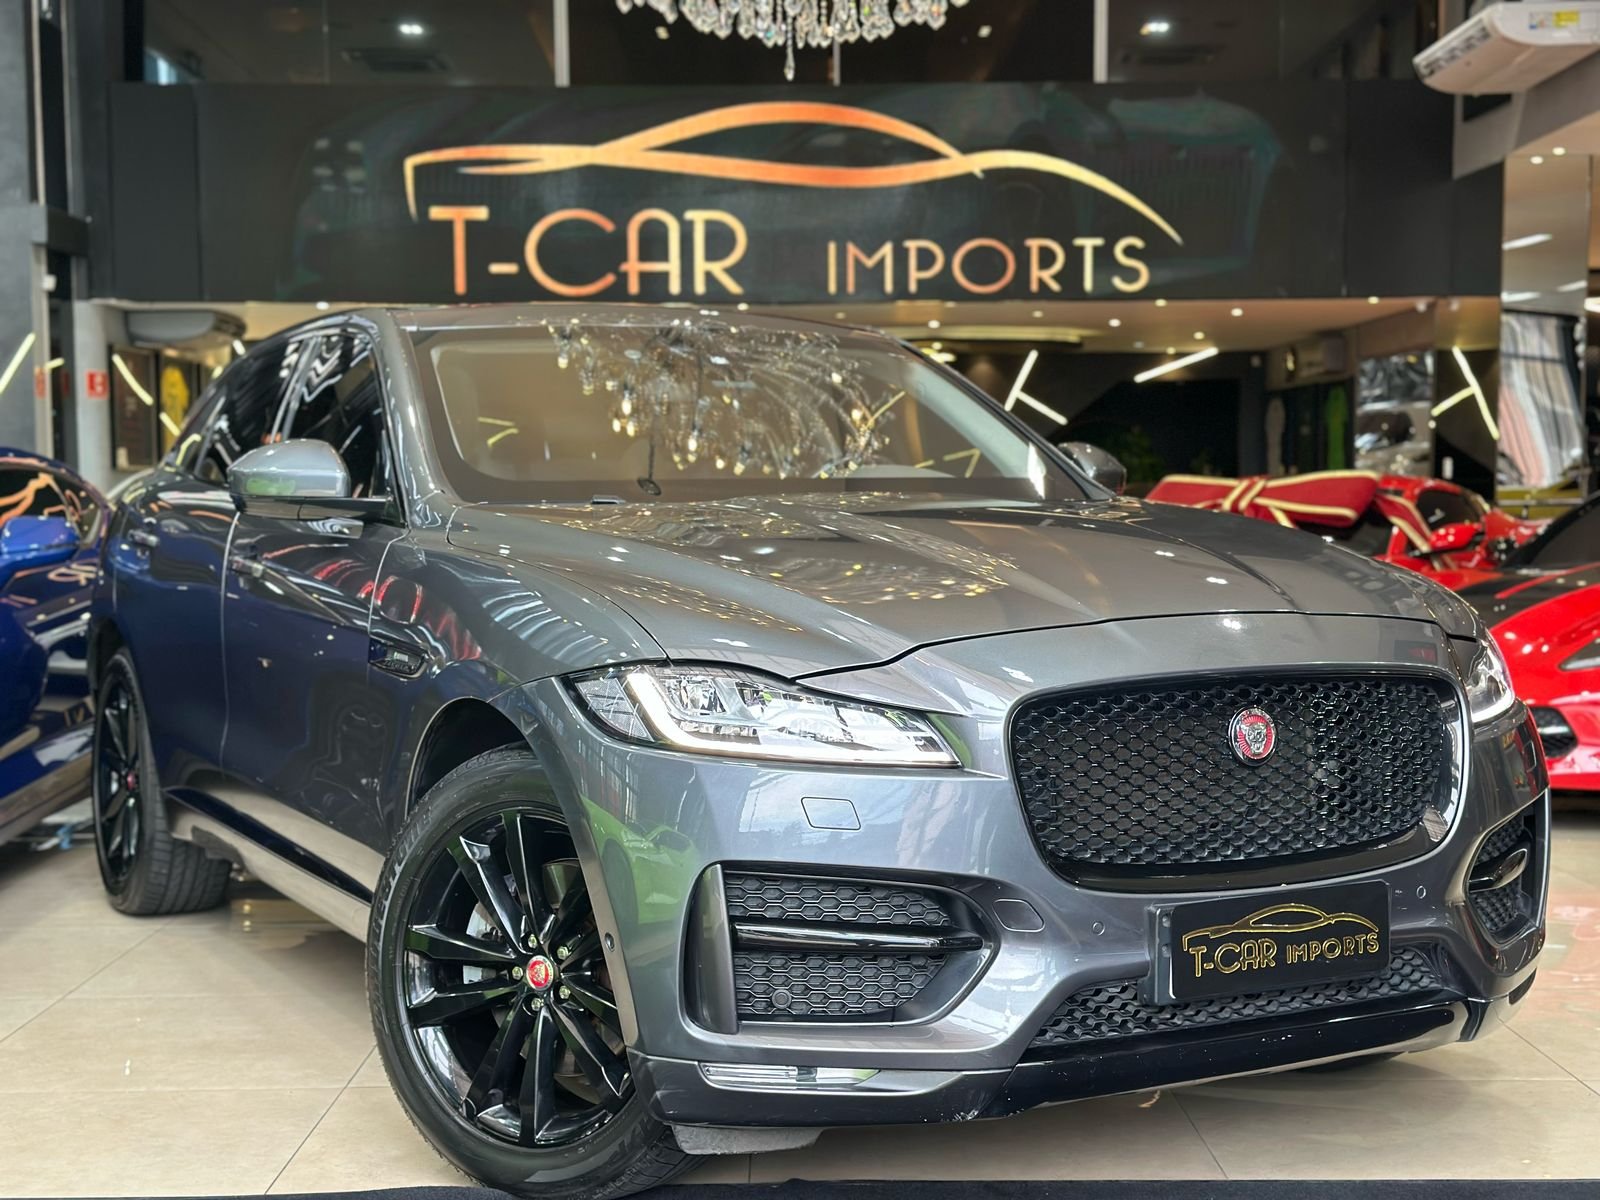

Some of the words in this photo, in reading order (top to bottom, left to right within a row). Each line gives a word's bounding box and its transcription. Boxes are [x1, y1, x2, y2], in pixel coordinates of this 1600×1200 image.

[428, 205, 748, 297] T-CAR
[826, 237, 1151, 294] IMPORTS
[1189, 937, 1277, 978] T-CAR
[1286, 933, 1380, 964] IMPORTS
